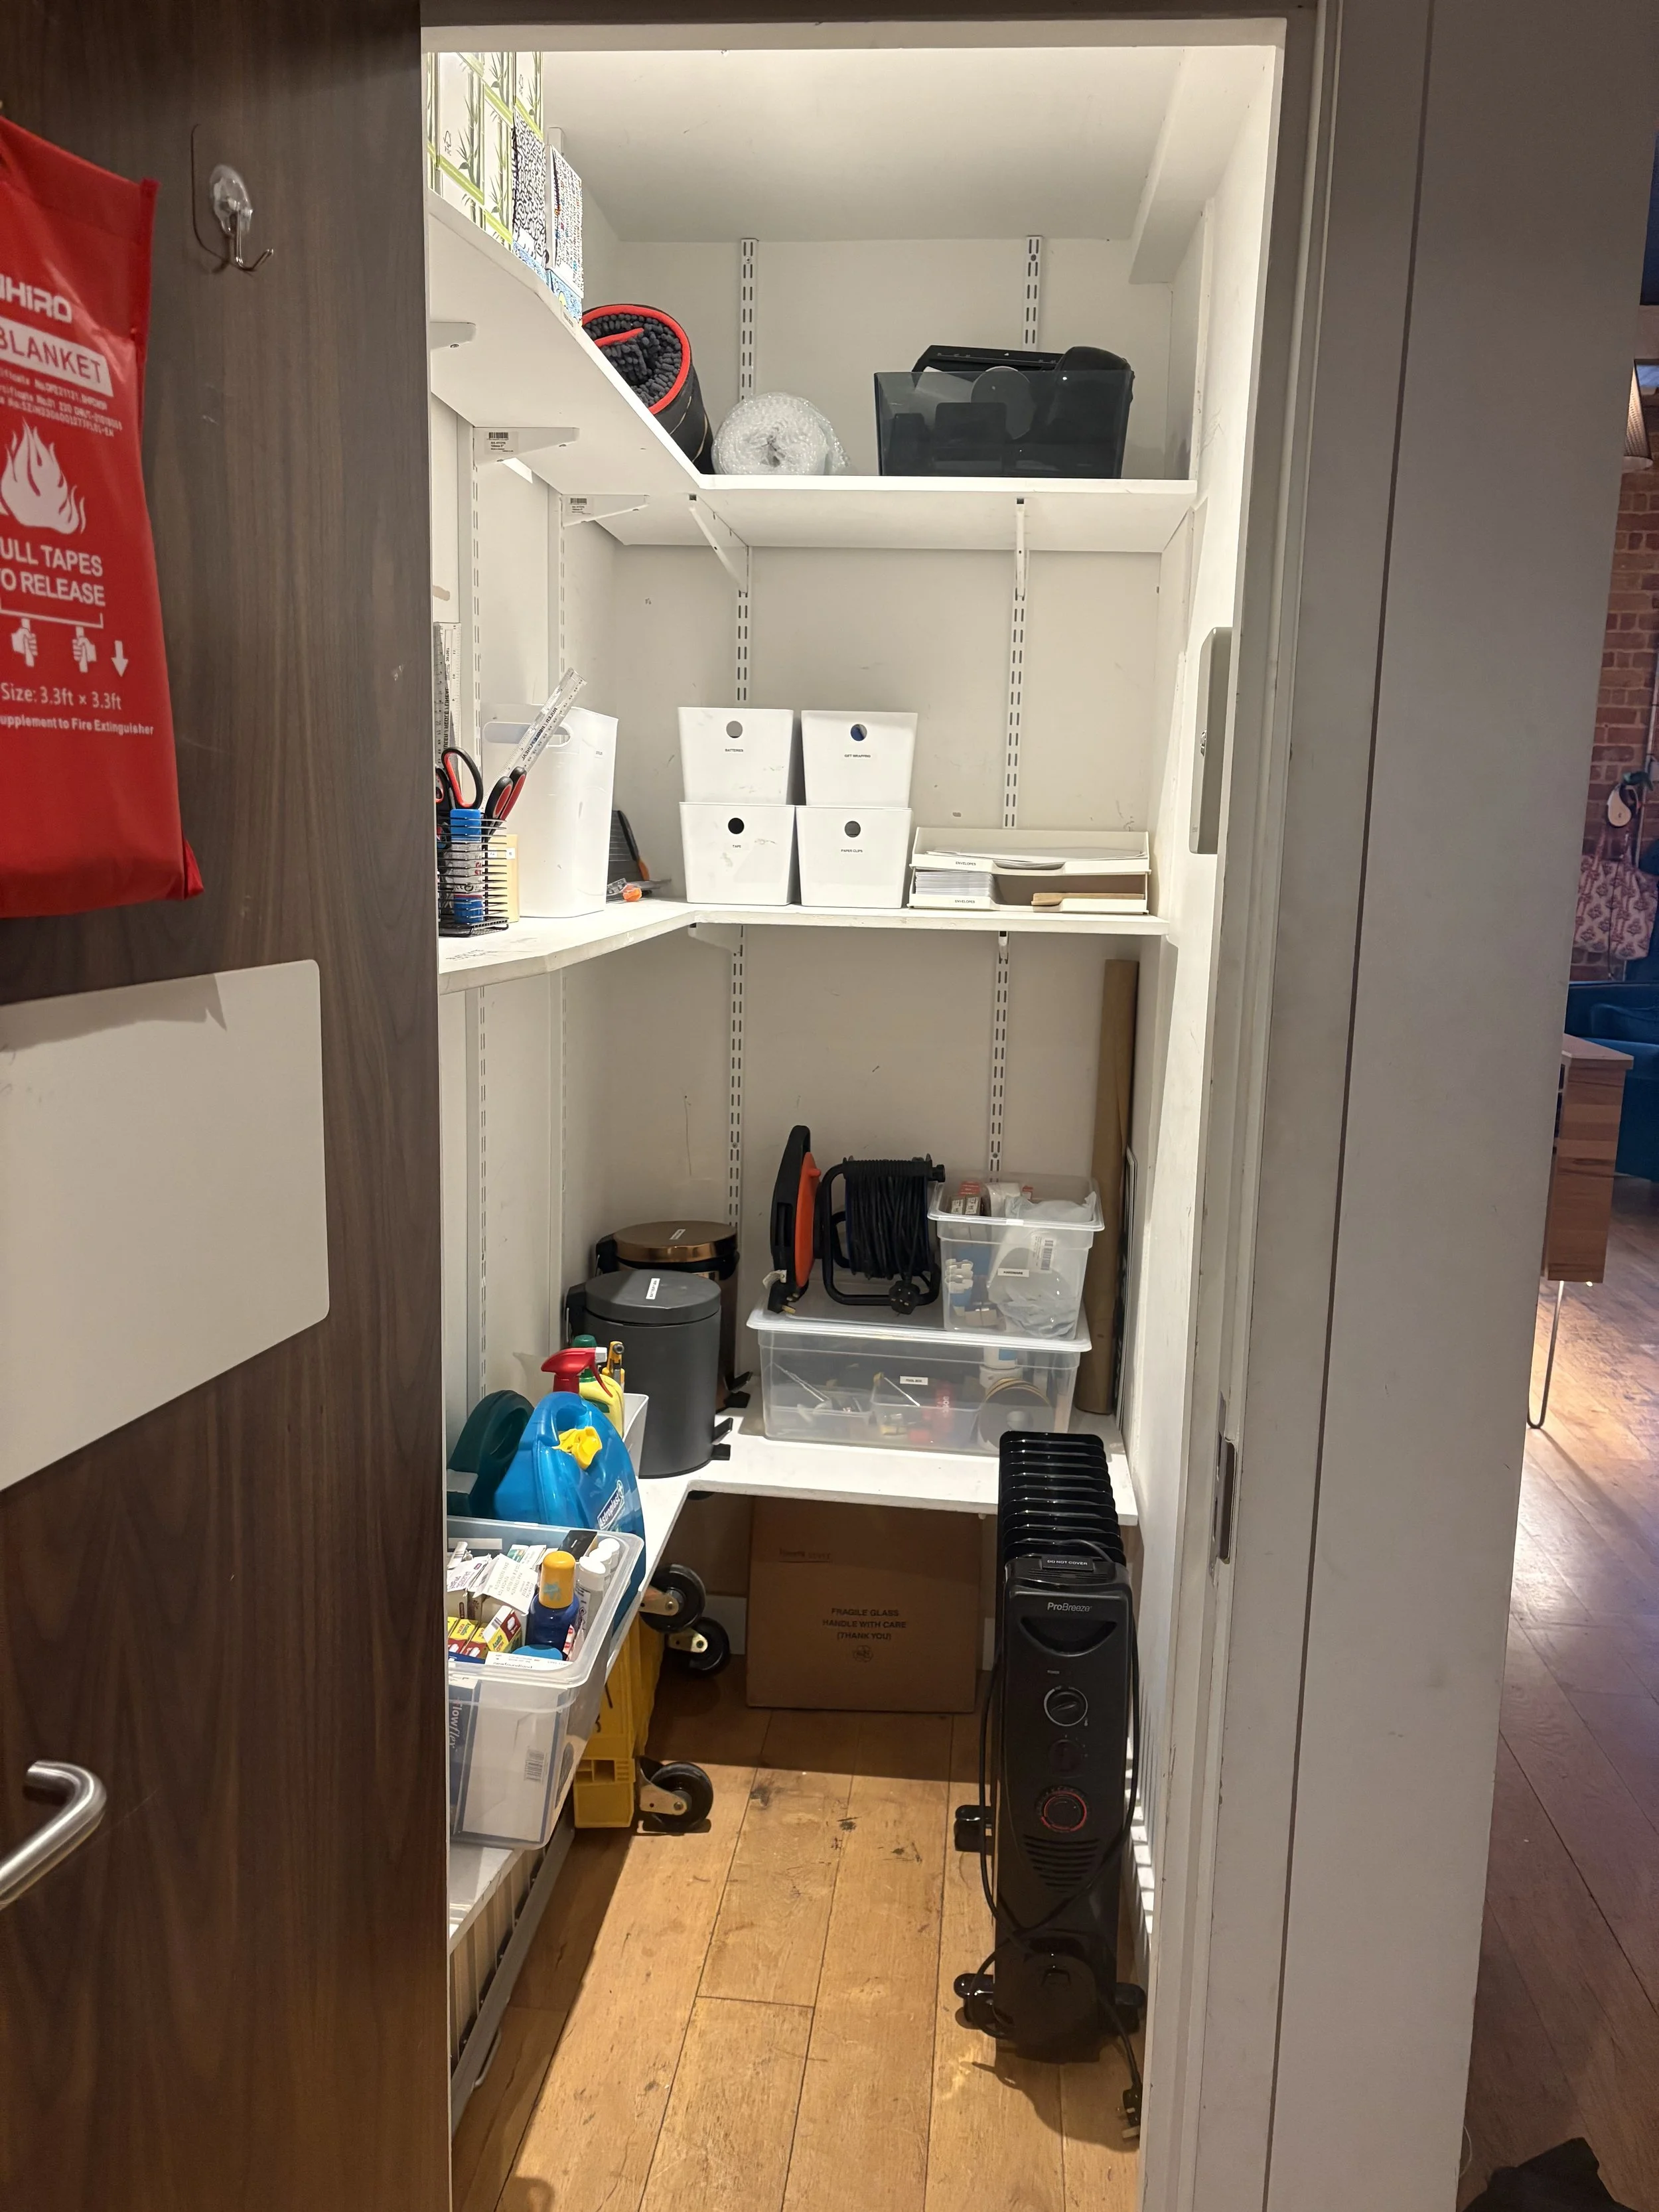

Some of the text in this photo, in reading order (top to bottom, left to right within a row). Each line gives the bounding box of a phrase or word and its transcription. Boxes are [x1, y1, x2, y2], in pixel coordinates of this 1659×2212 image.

[0, 537, 104, 577] ULL TAPES
[0, 567, 106, 607] O RELEASE
[1, 682, 37, 701] Size:
[40, 686, 74, 705] 3.3ft
[92, 691, 121, 710] 3.3ft
[0, 714, 154, 735] upplement to Fire Extinguisher
[599, 1492, 620, 1527] Astroplast
[831, 1607, 868, 1616] FRAGILE
[1047, 1602, 1090, 1612] ProBreeze
